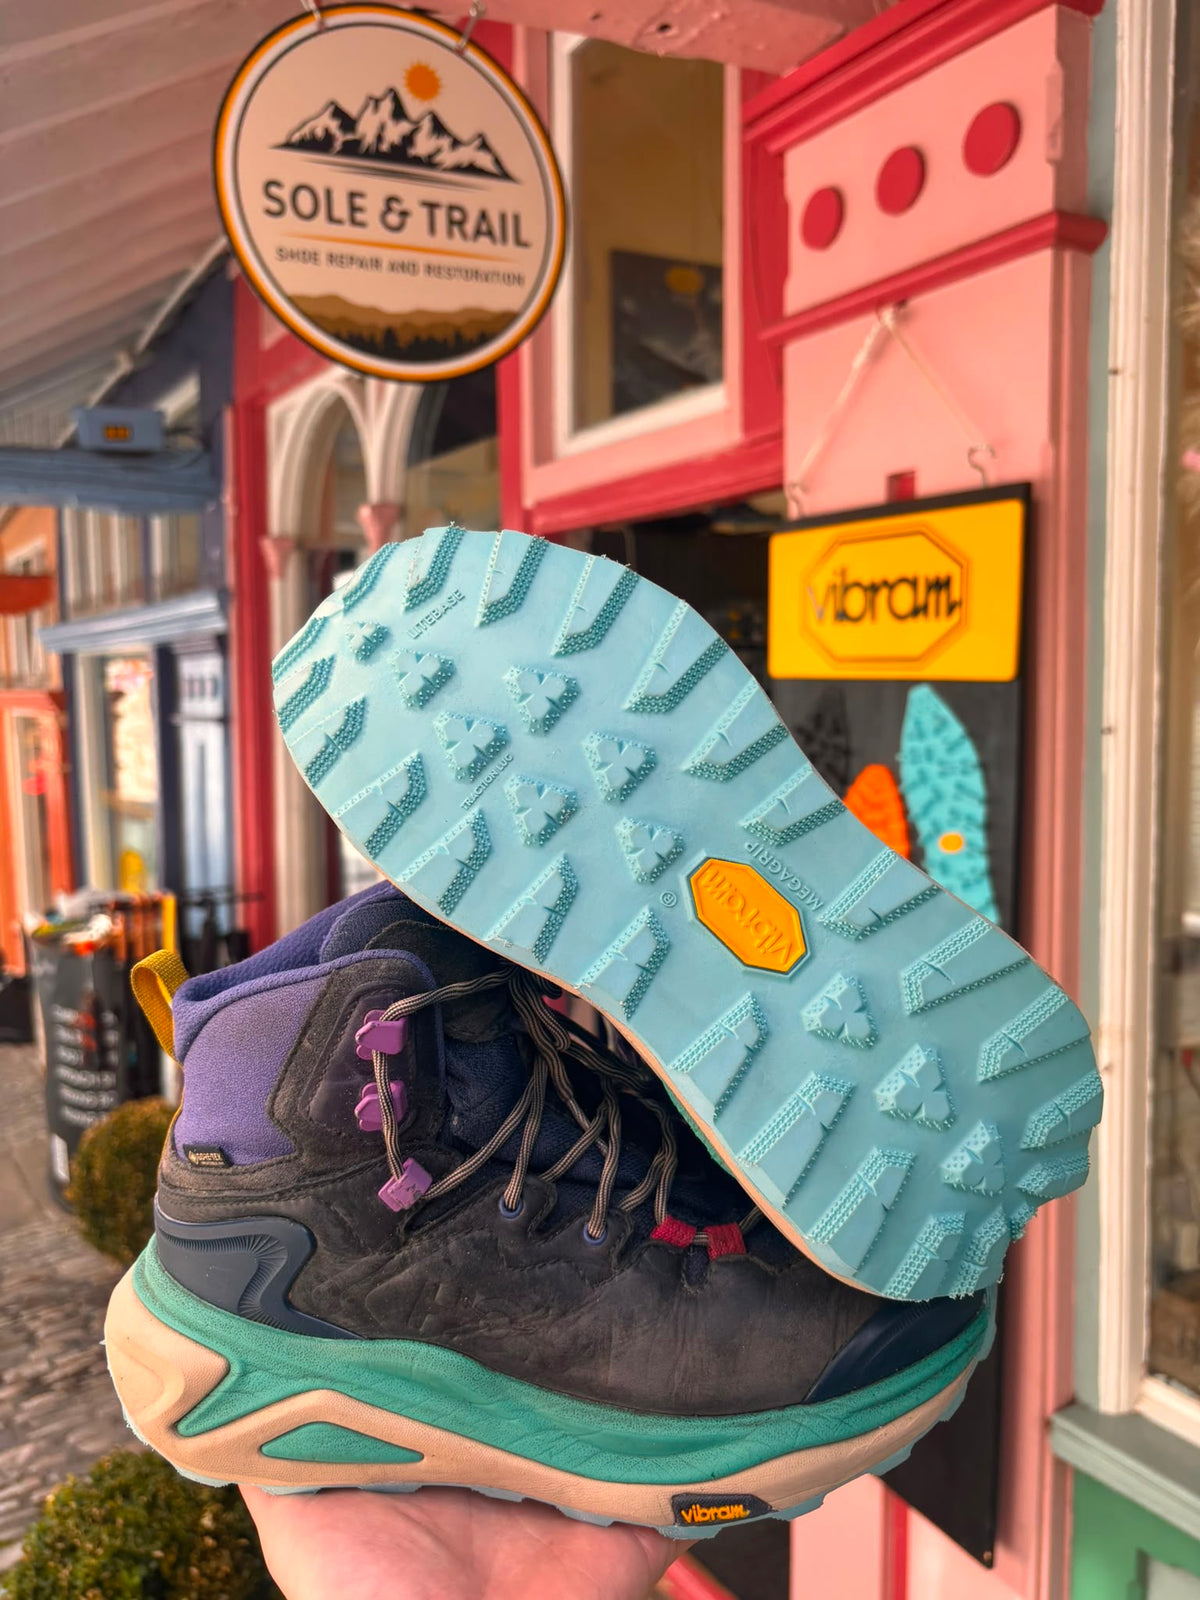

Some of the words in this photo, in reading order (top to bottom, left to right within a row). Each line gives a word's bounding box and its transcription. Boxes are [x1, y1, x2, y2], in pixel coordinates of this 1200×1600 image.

[263, 179, 368, 229] SOLE
[379, 194, 412, 233] &
[419, 199, 531, 249] TRAIL
[275, 247, 321, 266] SHOE
[325, 251, 383, 273] REPAIR
[387, 260, 419, 277] AND
[423, 264, 526, 287] RESTORATION
[407, 589, 466, 640] LITEBASE
[460, 769, 499, 810] TRACTION
[495, 753, 514, 771] LUG
[745, 841, 824, 912] MEGAGRIP
[700, 867, 793, 965] vibram
[681, 1504, 750, 1523] vibram
